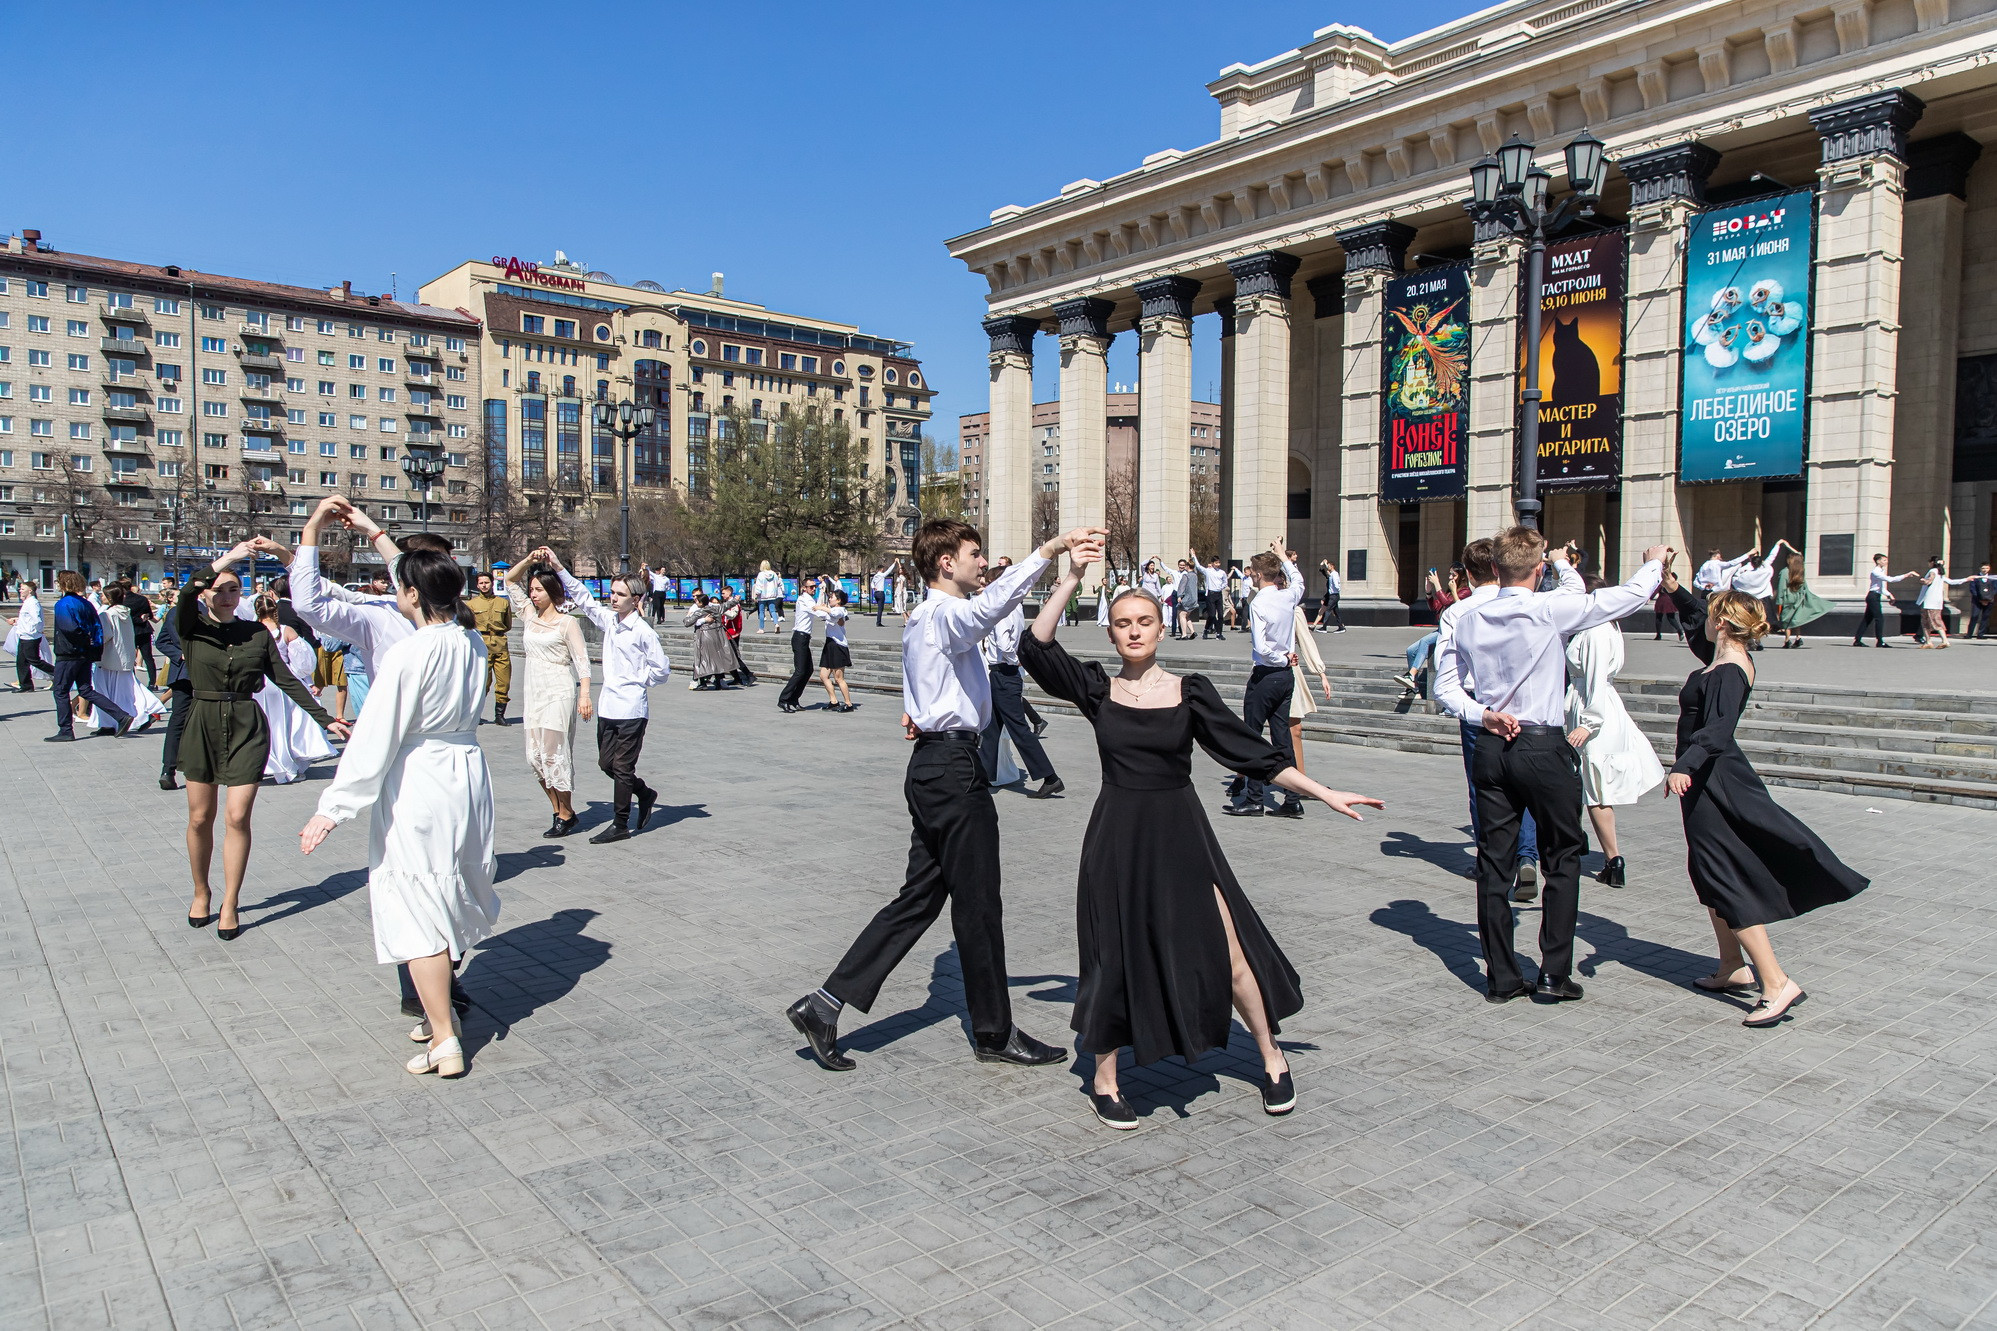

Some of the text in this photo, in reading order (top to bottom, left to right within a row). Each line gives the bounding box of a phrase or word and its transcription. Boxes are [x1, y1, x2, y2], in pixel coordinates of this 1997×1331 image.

[1552, 249, 1592, 269] МХАТ
[1707, 251, 1720, 265] 31
[1749, 244, 1755, 257] 1
[1756, 238, 1790, 257] ИЮНЯ
[492, 255, 537, 282] GRAND
[505, 256, 585, 292] AUTOGRAPH
[1420, 282, 1428, 294] 21
[1430, 279, 1447, 292] МАЯ
[1542, 274, 1600, 296] ГАСТРОЛИ
[1571, 287, 1607, 305] ИЮНЯ
[1537, 403, 1597, 424] МАСТЕР
[1690, 388, 1798, 421] ЛЕБЕДИНОЕ
[1561, 423, 1572, 438] И
[1714, 416, 1771, 442] ОЗЕРО
[1392, 412, 1458, 469] КОНЁК
[1537, 437, 1610, 457] АРГАРИТА
